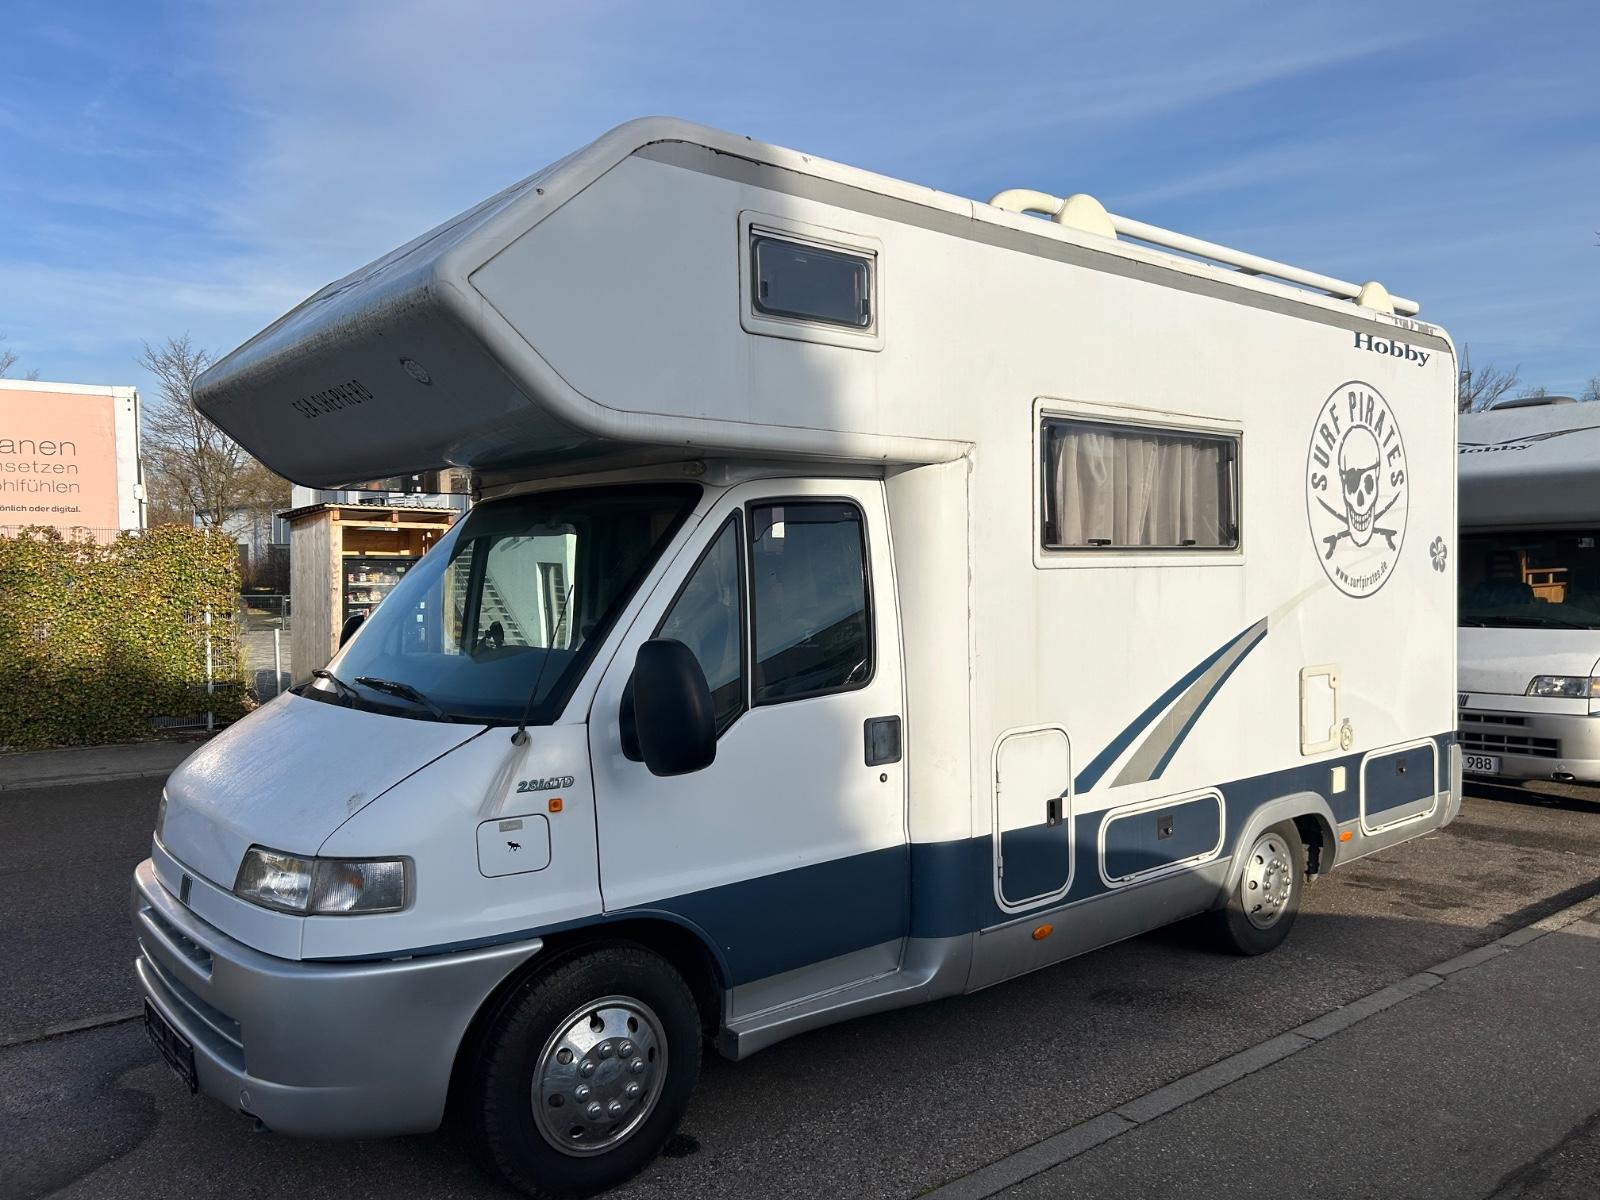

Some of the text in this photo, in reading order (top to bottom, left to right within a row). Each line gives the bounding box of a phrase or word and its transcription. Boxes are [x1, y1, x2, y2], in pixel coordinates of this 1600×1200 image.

[1353, 331, 1431, 367] Hobby
[291, 379, 374, 418] SEA SHEPHERD
[1311, 391, 1405, 491] SURF PIRATES
[0, 460, 78, 475] setzen
[0, 479, 80, 493] hlfühlen
[28, 505, 50, 513] oder
[51, 505, 81, 514] digital.
[1467, 756, 1492, 770] 988
